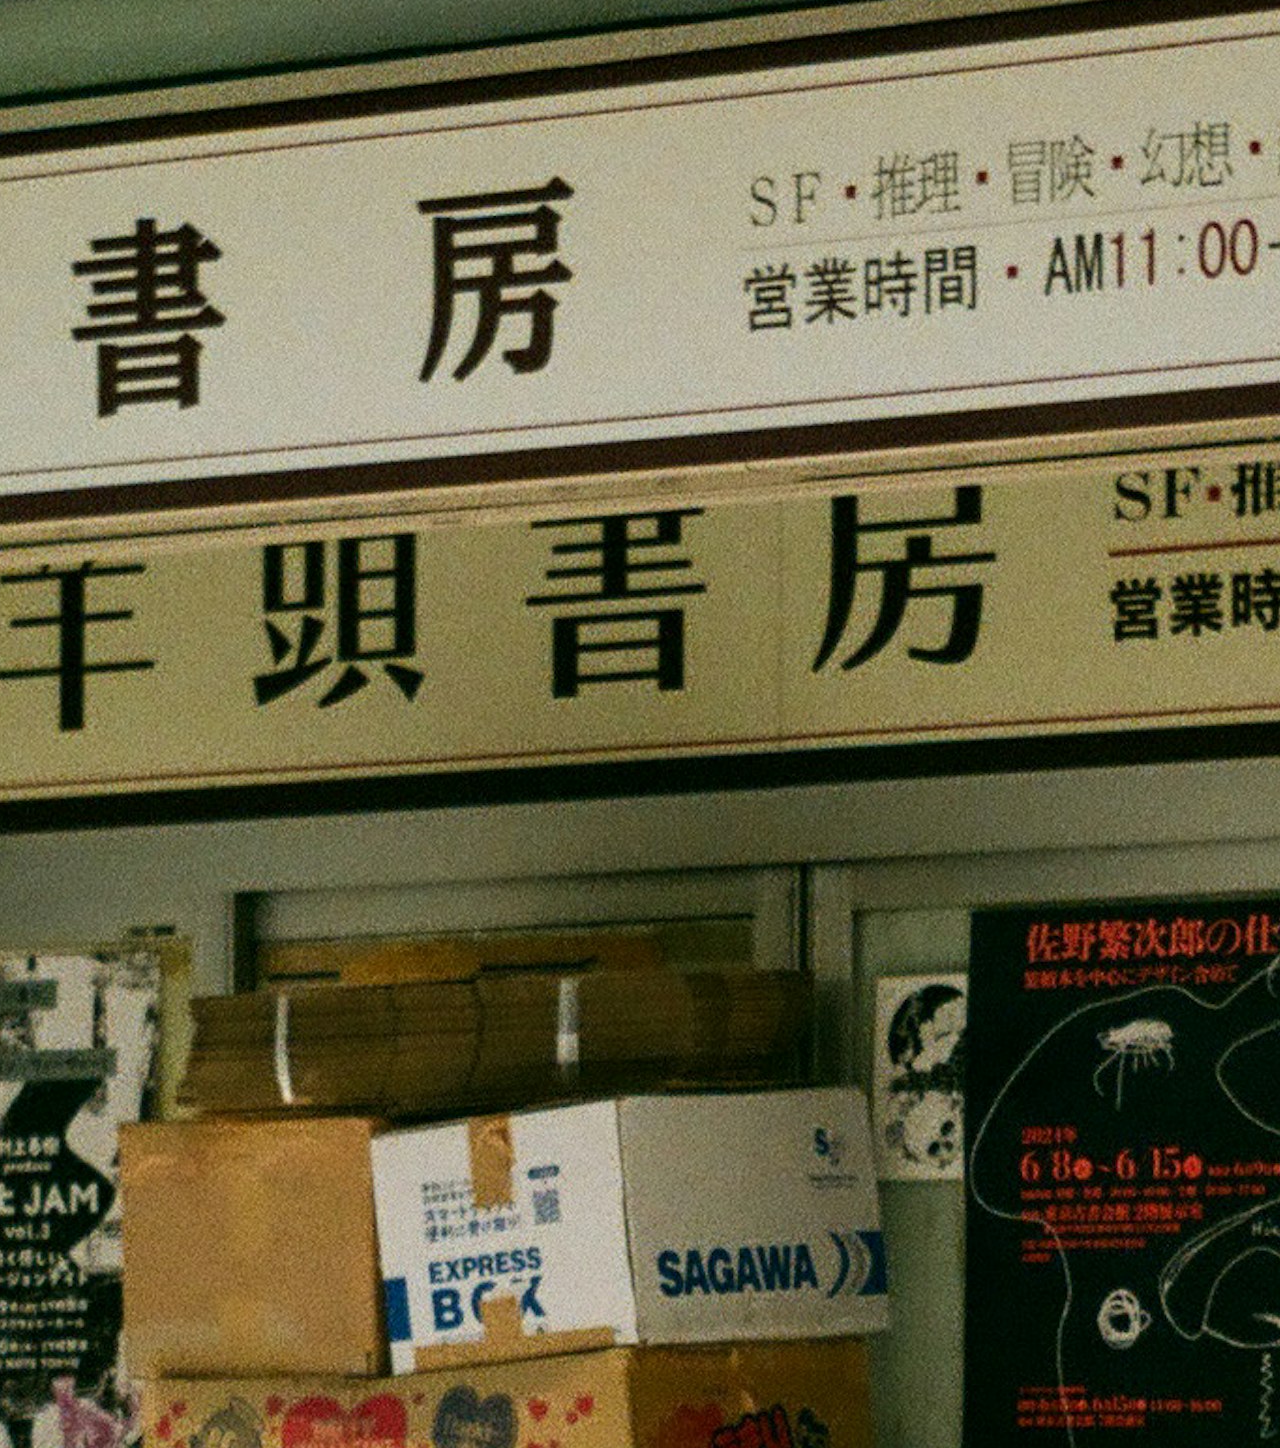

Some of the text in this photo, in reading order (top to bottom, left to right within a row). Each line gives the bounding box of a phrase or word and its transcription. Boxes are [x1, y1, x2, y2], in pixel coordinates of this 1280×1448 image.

[22, 1180, 101, 1217] JAM
[429, 1247, 542, 1284] EXPRESS
[657, 1242, 819, 1299] SAGAWA
